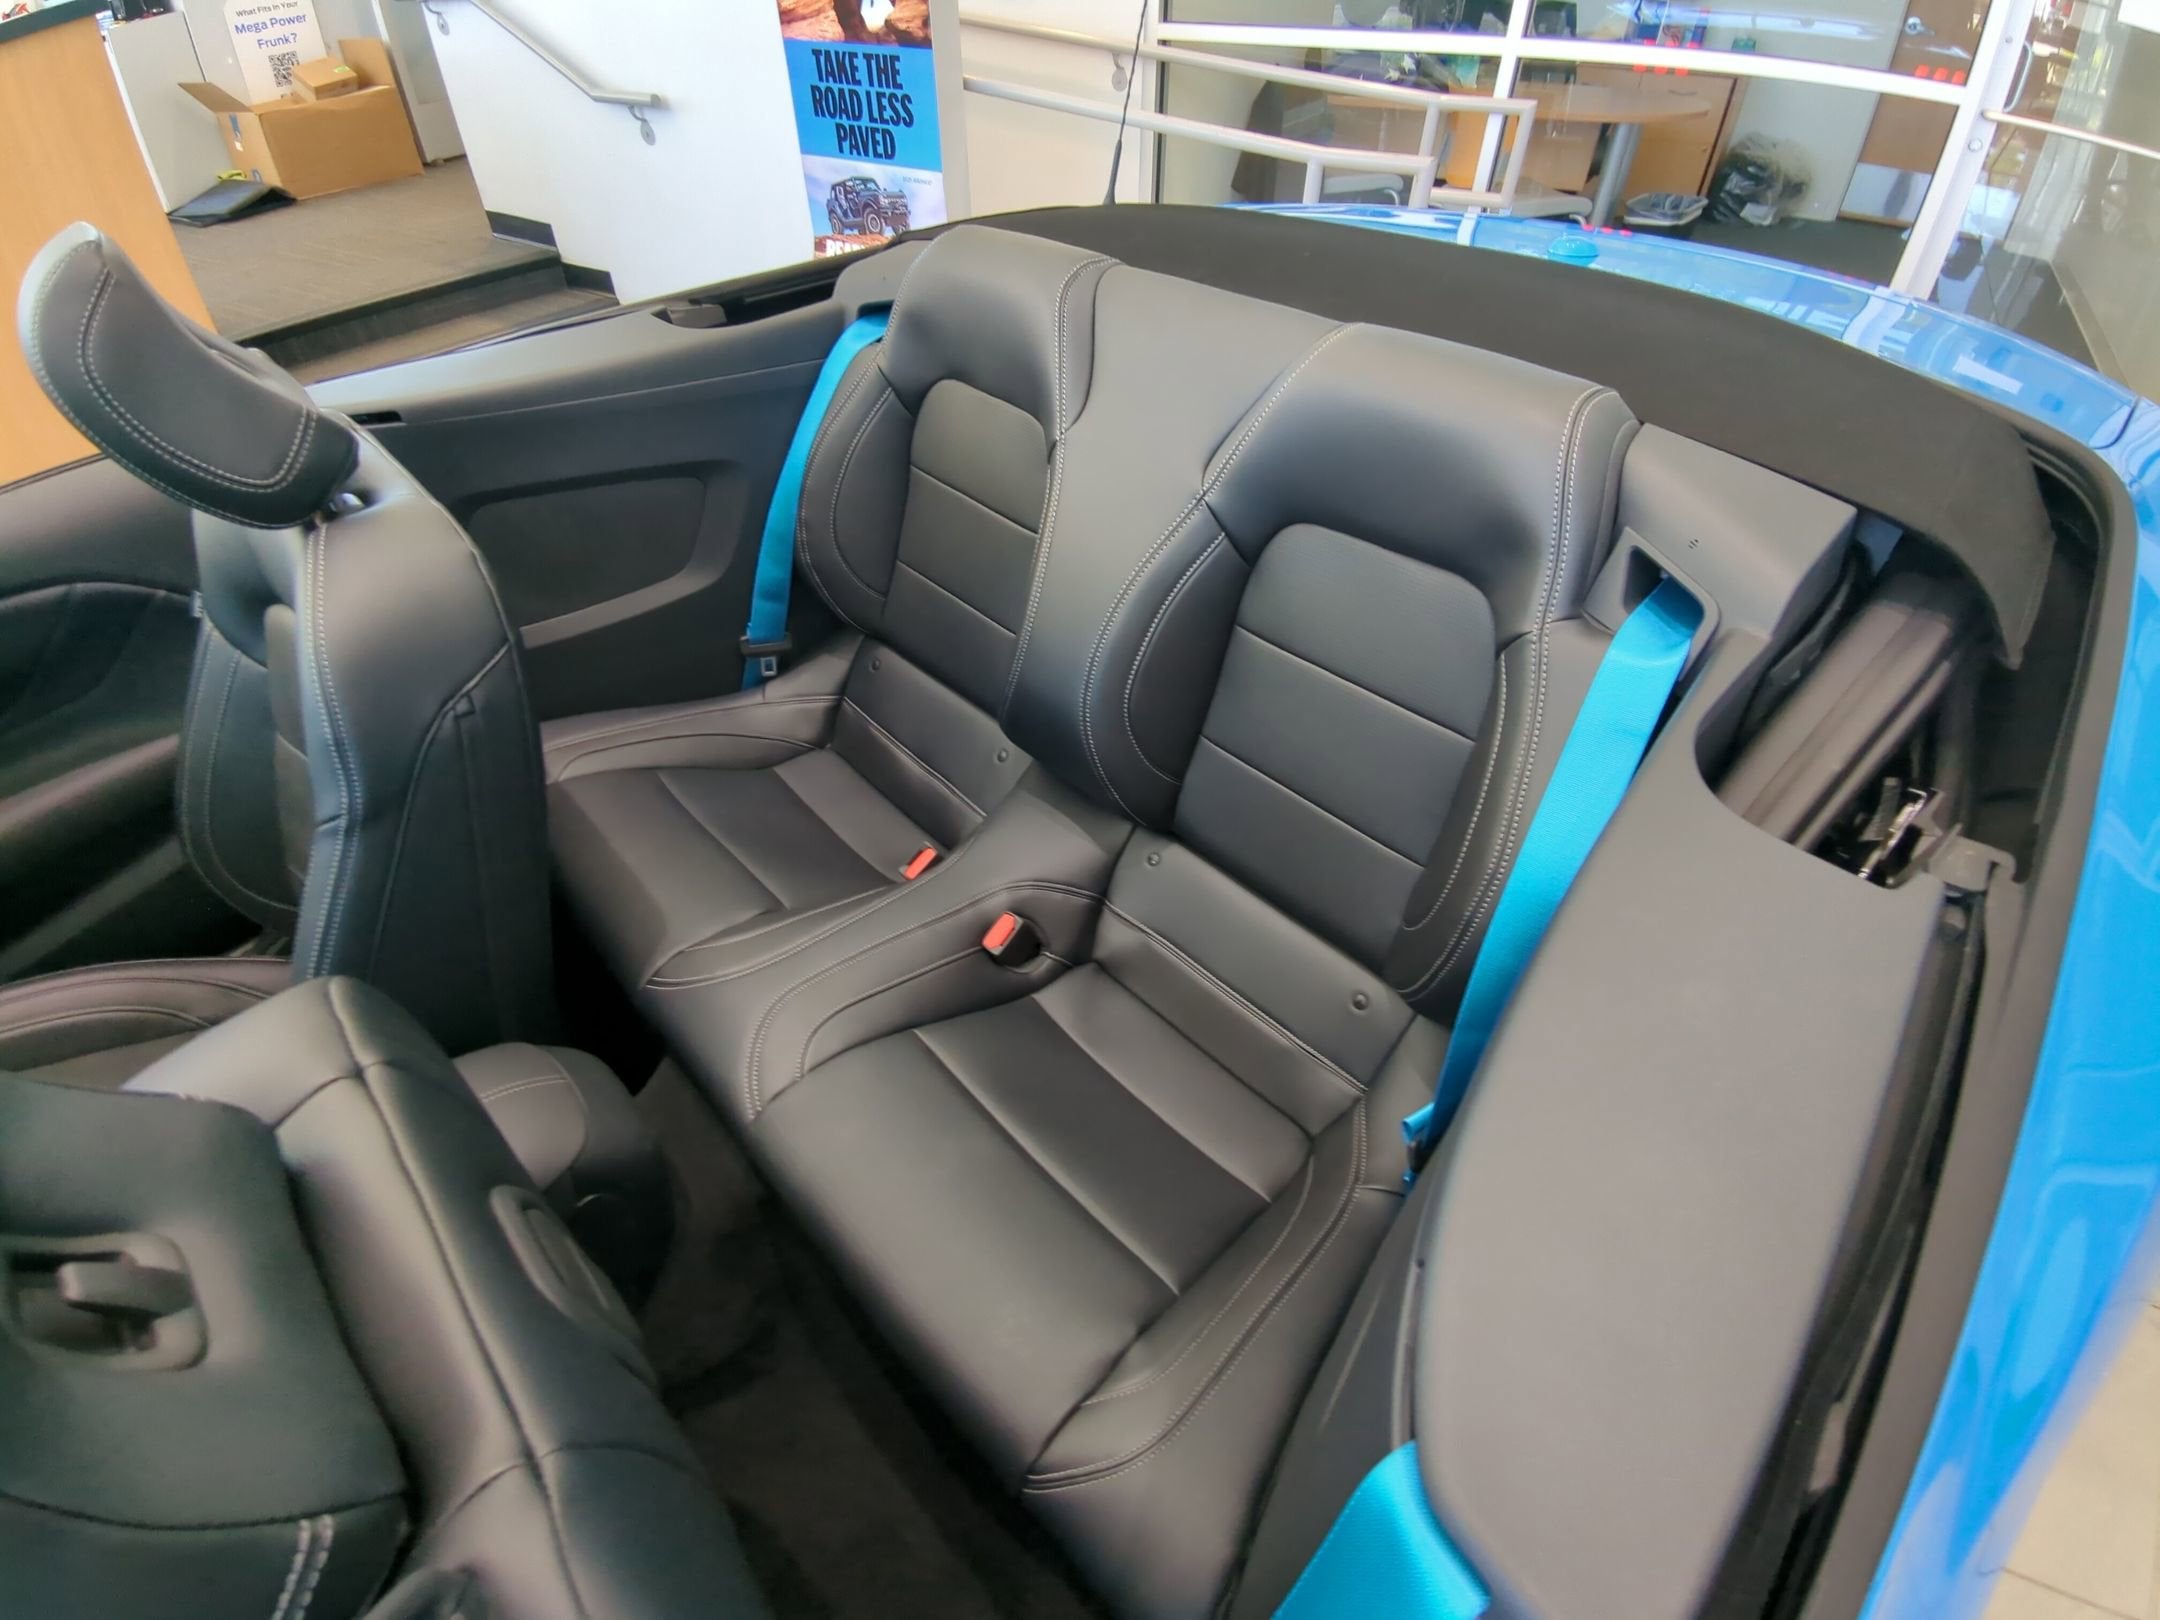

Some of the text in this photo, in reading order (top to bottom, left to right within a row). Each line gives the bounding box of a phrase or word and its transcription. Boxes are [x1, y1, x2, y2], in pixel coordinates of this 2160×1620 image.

[235, 8, 257, 17] What
[257, 5, 272, 14] Fits
[280, 1, 298, 9] Your
[234, 14, 307, 35] Mega Power
[257, 32, 297, 49] Frunk?
[811, 48, 903, 91] TAKE THE
[810, 84, 914, 128] ROAD LESS
[835, 122, 896, 161] PAVED
